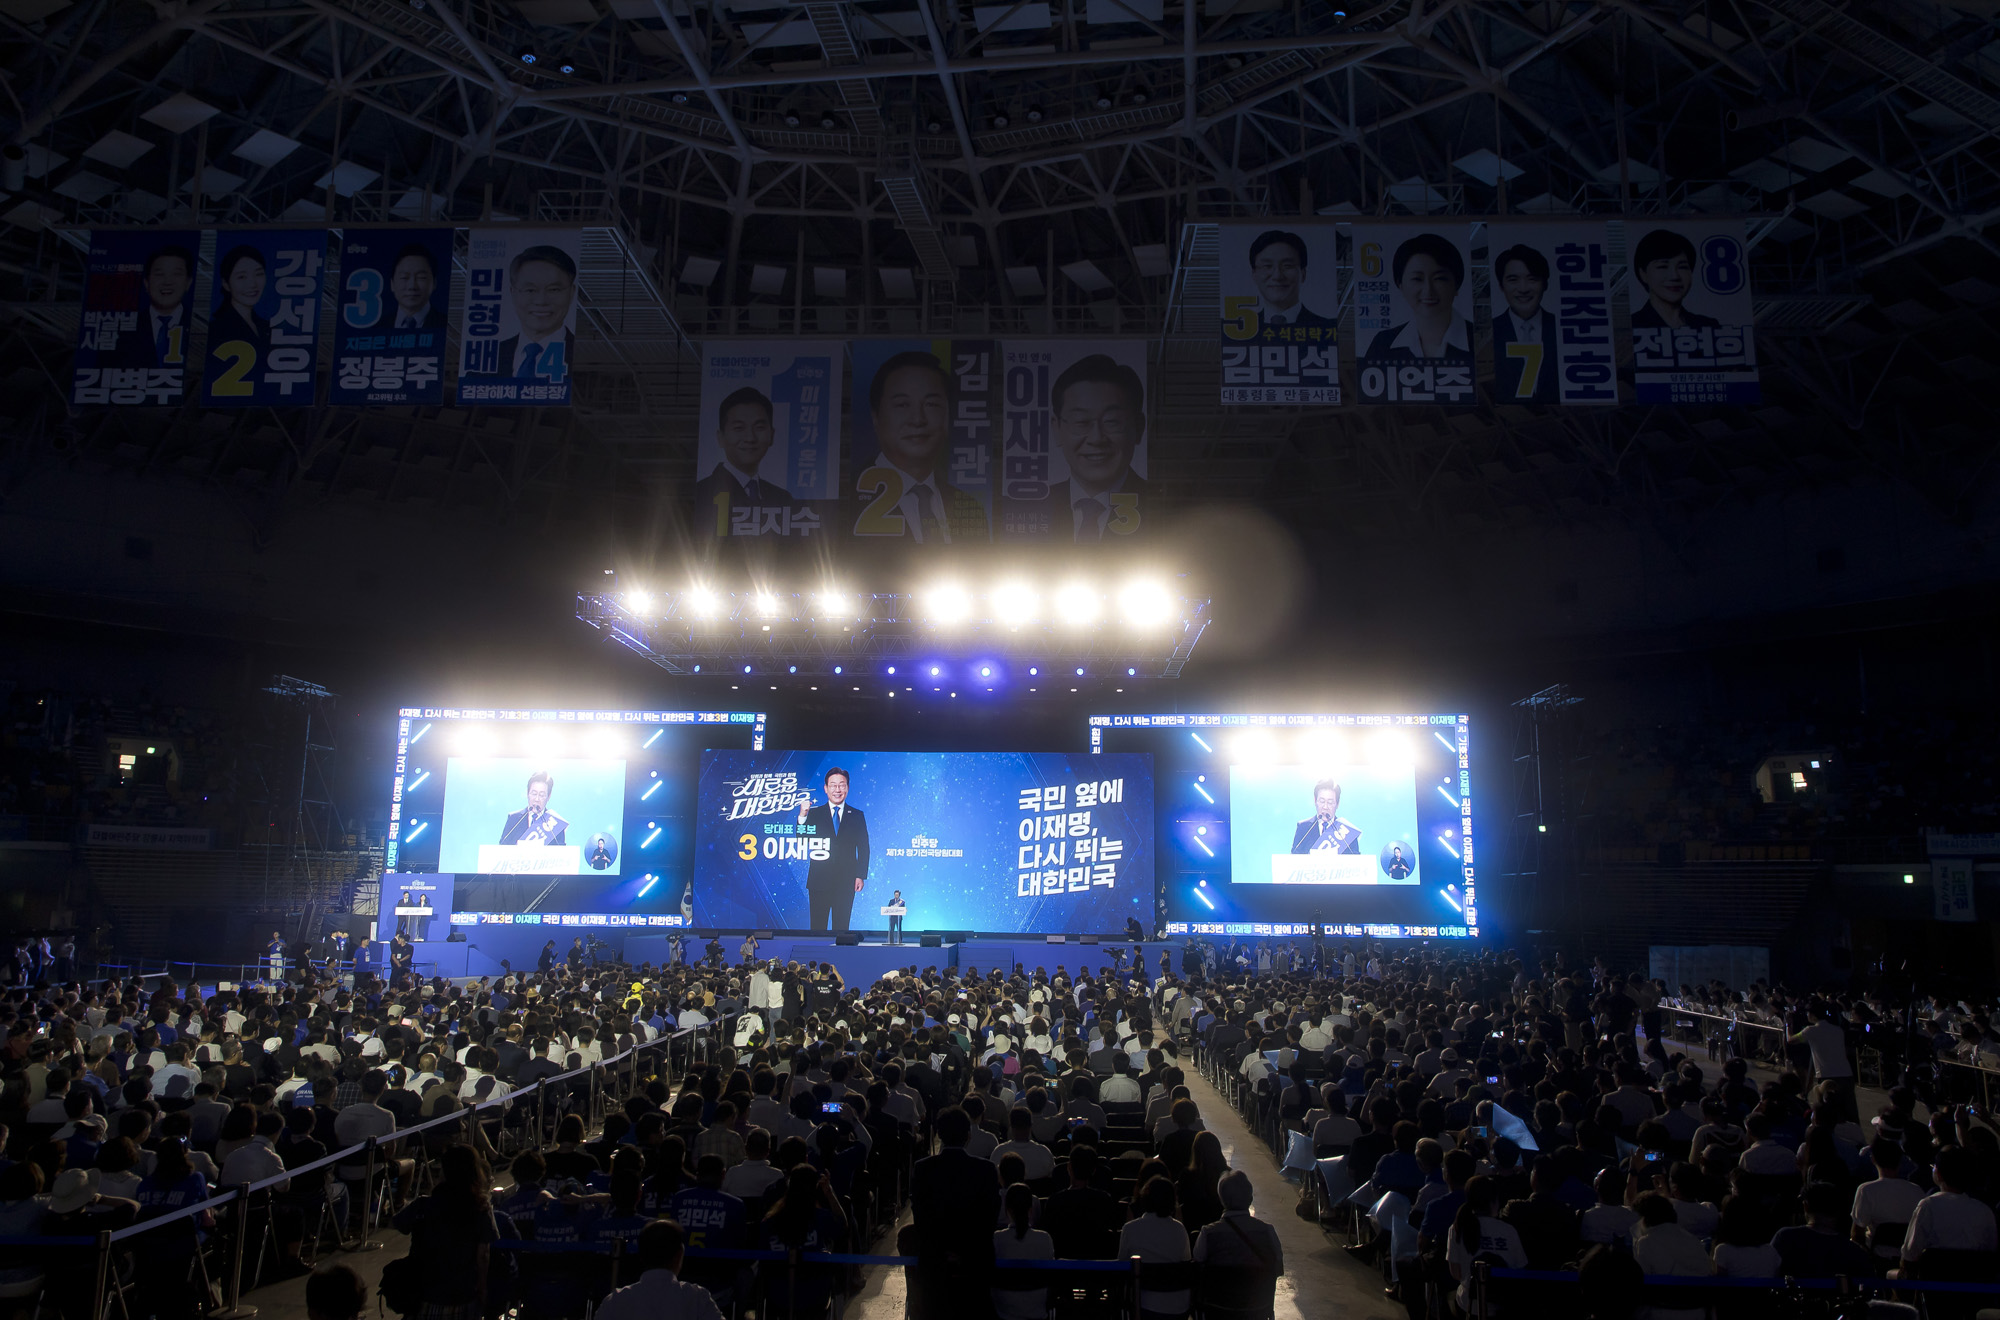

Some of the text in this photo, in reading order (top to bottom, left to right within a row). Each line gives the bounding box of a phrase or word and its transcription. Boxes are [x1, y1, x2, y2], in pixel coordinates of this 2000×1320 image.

[1360, 242, 1383, 278] 6
[1701, 235, 1745, 295] 8
[343, 267, 384, 329] 3
[1359, 281, 1389, 292] 민주당
[264, 249, 325, 395] 강선우
[465, 269, 504, 374] 민형배
[1223, 296, 1259, 341] 5
[1263, 327, 1338, 341] 수석전략가
[1555, 243, 1614, 399] 한준호
[80, 331, 120, 351] 사람
[163, 324, 184, 364] 1
[345, 333, 434, 351] 지금은 싸울 때
[1633, 325, 1754, 368] 전현희
[211, 340, 257, 396] 2
[338, 356, 438, 390] 정봉주
[536, 341, 568, 384] 4
[711, 356, 770, 367] 더불어민주당
[1222, 345, 1339, 384] 김민석
[1505, 342, 1544, 398] 7
[74, 367, 184, 405] 김병주
[462, 385, 568, 400] 검찰해체 선봉장!
[1222, 389, 1277, 402] 대통령을
[1361, 366, 1473, 401] 이언주
[952, 352, 990, 484] 김두관
[1006, 365, 1050, 500] 이재명
[713, 492, 730, 536] 1
[854, 465, 905, 536] 2
[1107, 493, 1141, 536] 3
[732, 506, 820, 536] 김지수
[424, 709, 441, 718] 다시
[443, 709, 460, 719] 뛰는
[462, 710, 495, 720] 대한민국
[499, 711, 530, 720] 기호3번
[533, 712, 556, 721] 이재명
[559, 711, 575, 721] 국민
[577, 712, 594, 721] 옆에
[595, 712, 622, 722] 이재명,
[624, 712, 641, 722] 다시
[643, 712, 659, 722] 뛰는
[661, 713, 694, 722] 대한민국
[698, 713, 729, 722] 기호3번
[731, 713, 755, 723] 이재명
[1114, 717, 1131, 726] 다시
[1133, 717, 1150, 726] 뛰는
[1151, 716, 1185, 726] 대한민국
[1189, 716, 1221, 725] 기호3번
[1222, 716, 1248, 725] 이재명
[1249, 716, 1266, 725] 국민
[1269, 716, 1286, 725] 옆에
[1318, 716, 1336, 725] 다시
[1357, 716, 1391, 725] 대한민국
[1396, 716, 1428, 725] 기호3번
[1430, 715, 1456, 724] 이재명
[1459, 736, 1468, 769] 기호3번
[732, 778, 797, 796] 새로운
[1018, 778, 1124, 813] 국민 옆에
[1460, 770, 1469, 796] 이재명
[387, 841, 398, 867] 이재명
[396, 756, 406, 773] 다시
[1461, 798, 1471, 816] 국민
[764, 824, 816, 834] 당대표 후보
[911, 838, 938, 848] 민주당
[1018, 811, 1098, 842] 이재명,
[738, 834, 830, 860] 3 이재명
[886, 848, 963, 857] 제1차 정기전국당원대회
[1018, 836, 1123, 870] 다시 뛰는
[1017, 863, 1116, 898] 대한민국
[1464, 867, 1474, 885] 다시
[481, 913, 513, 924] 기호3번
[515, 913, 541, 924] 이재명
[542, 914, 559, 925] 국민
[562, 914, 579, 925] 옆에
[581, 915, 609, 925] 이재명,
[610, 915, 627, 925] 다시
[629, 915, 647, 926] 뛰는
[648, 915, 682, 926] 대한민국
[1192, 923, 1224, 934] 기호3번
[1226, 924, 1252, 934] 이재명
[1254, 924, 1272, 934] 국민
[1274, 924, 1291, 934] 옆에
[1324, 925, 1342, 935] 다시
[1344, 926, 1362, 935] 뛰는
[1404, 926, 1438, 936] 기호3번
[1439, 927, 1466, 937] 이재명
[678, 1208, 726, 1229] 김민석
